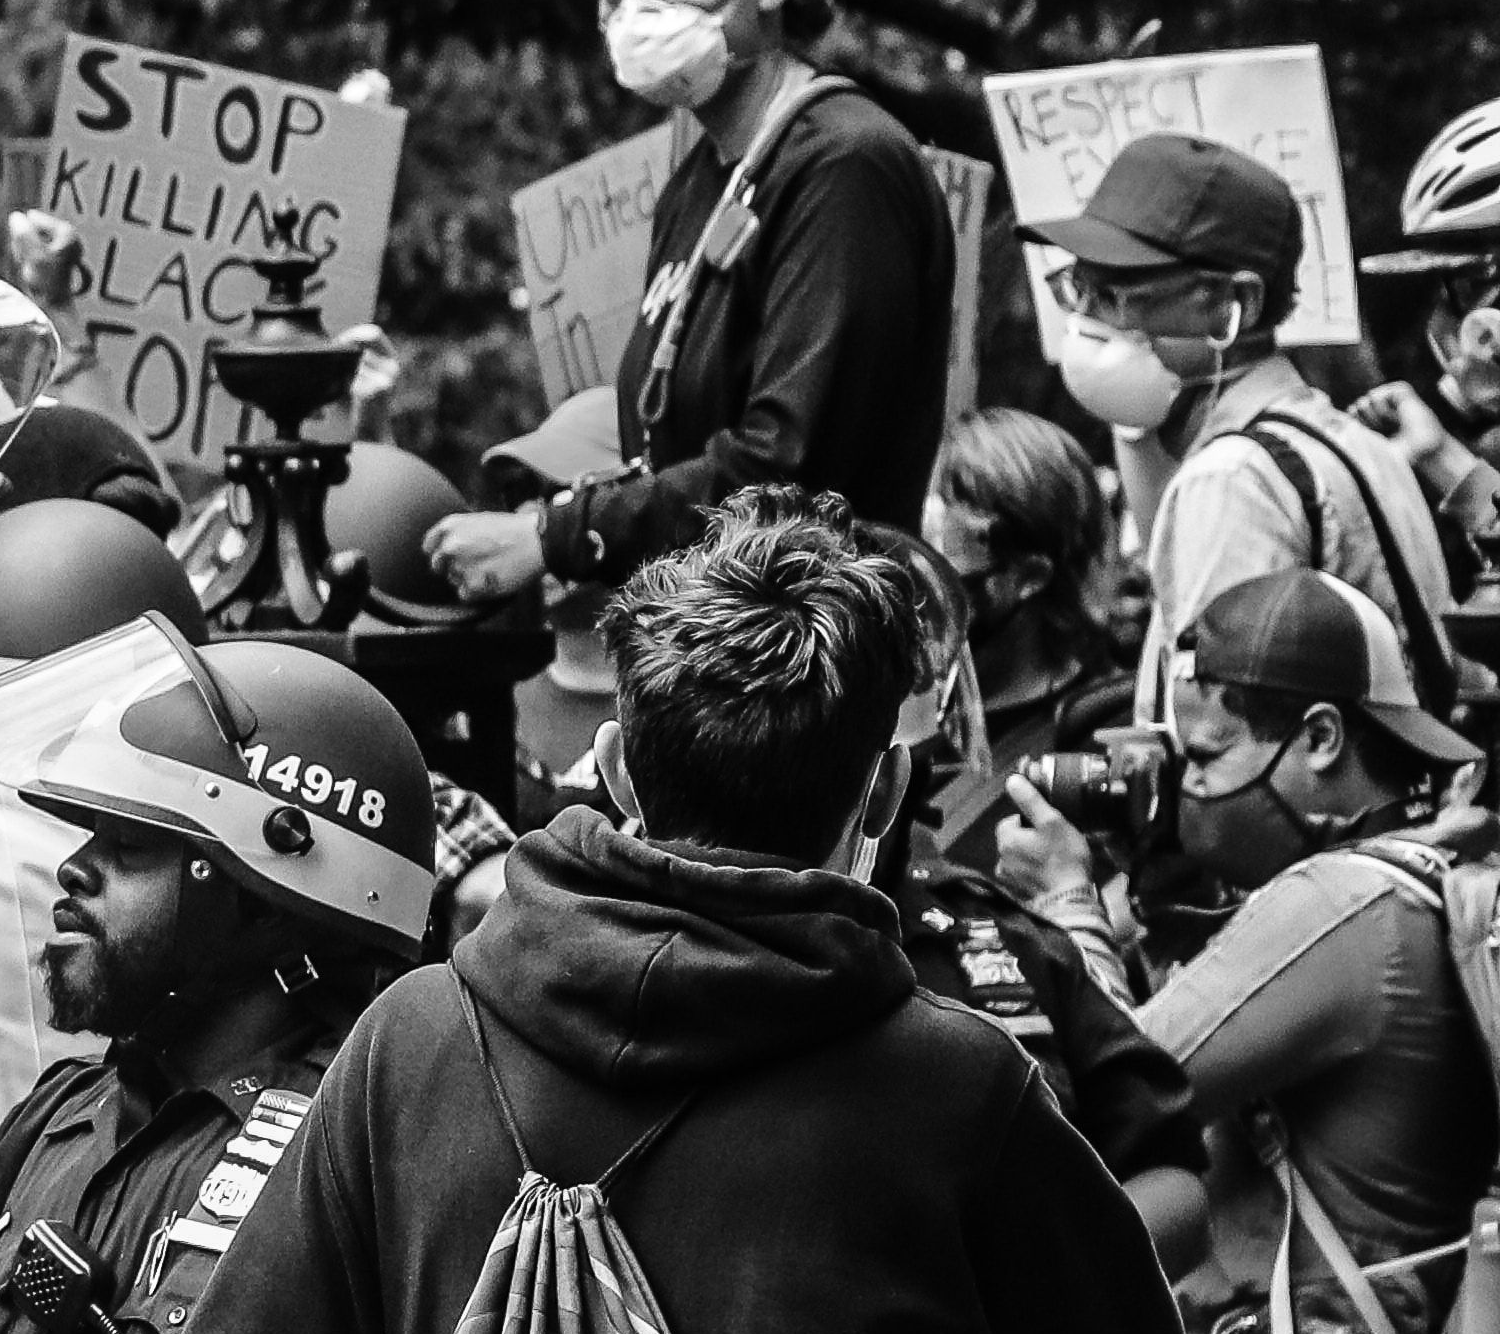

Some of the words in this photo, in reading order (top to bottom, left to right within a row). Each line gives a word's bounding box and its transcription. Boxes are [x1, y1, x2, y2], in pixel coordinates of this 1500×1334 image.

[77, 48, 324, 174] STOP
[1004, 66, 1212, 153] RESPECT
[50, 148, 340, 261] KILLING
[74, 236, 326, 324] LAC
[243, 744, 385, 828] 14918
